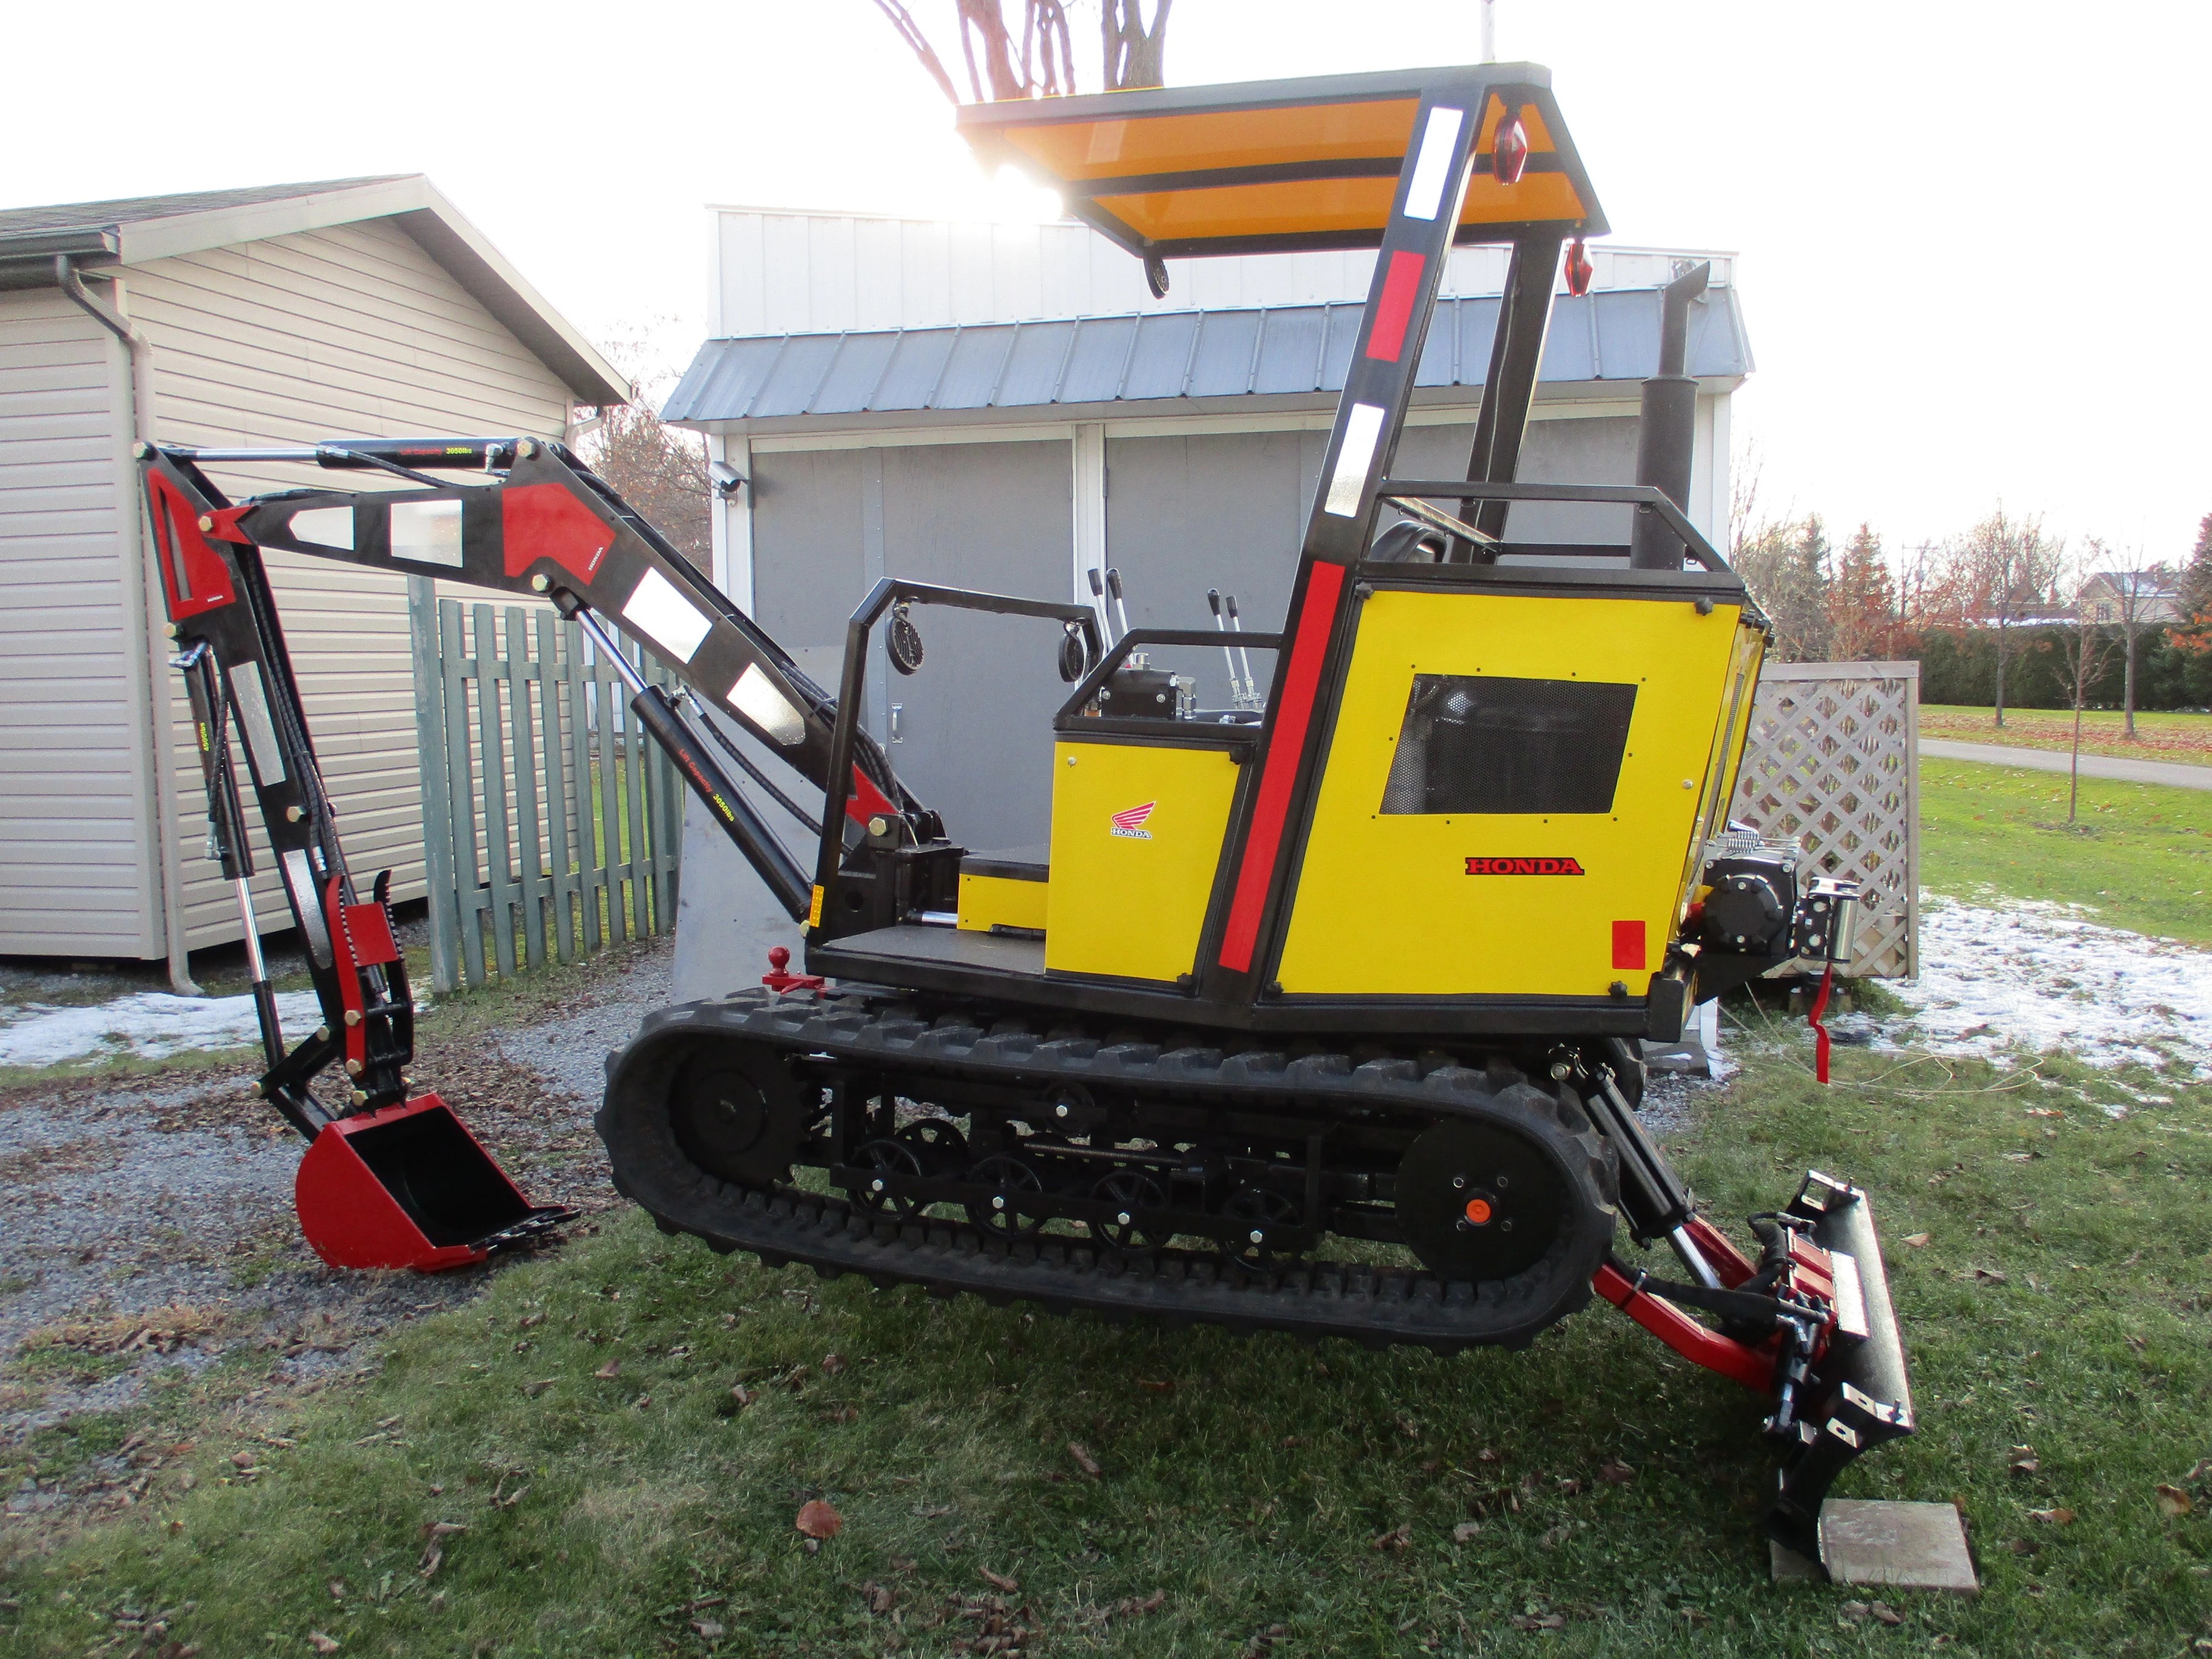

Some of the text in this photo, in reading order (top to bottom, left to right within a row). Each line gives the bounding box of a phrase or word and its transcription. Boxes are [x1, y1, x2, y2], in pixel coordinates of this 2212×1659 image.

[588, 547, 604, 571] HONDA
[713, 793, 735, 822] 3050lbs
[1112, 828, 1151, 838] HONDA
[1467, 859, 1583, 874] HONDA
